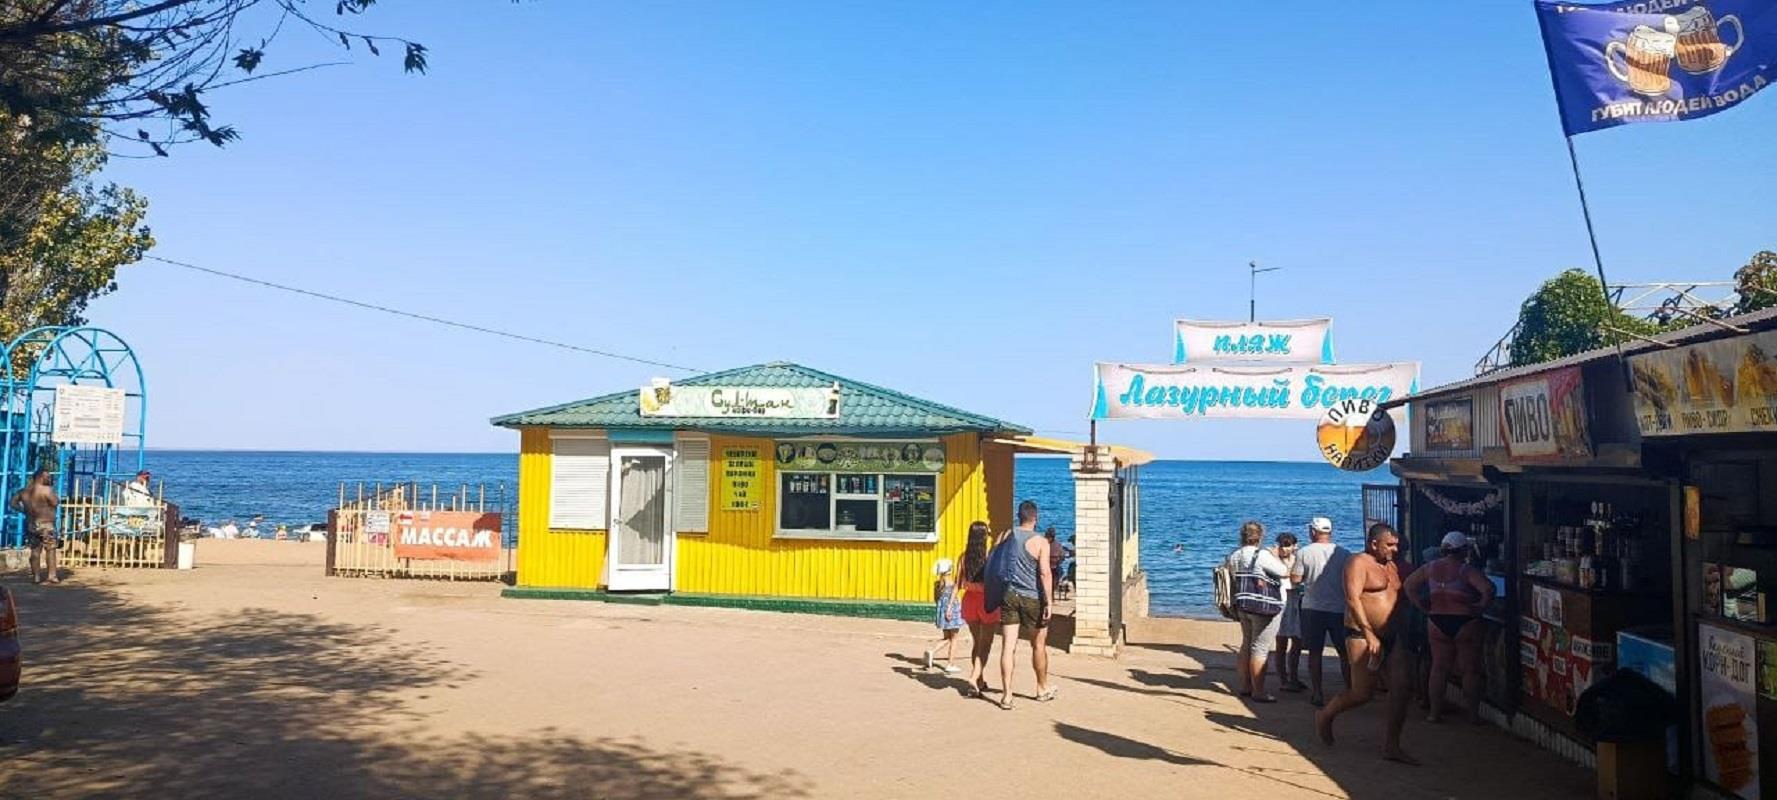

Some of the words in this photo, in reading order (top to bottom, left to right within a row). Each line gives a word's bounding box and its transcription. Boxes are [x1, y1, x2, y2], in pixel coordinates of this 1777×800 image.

[1591, 100, 1643, 122] ГУБИТ
[1644, 94, 1714, 116] ЛЮДЕЙ
[1714, 74, 1767, 107] ВОДА
[1119, 374, 1291, 416] Лазурный
[1328, 399, 1385, 423] ПИВО
[1505, 394, 1549, 443] ПИВО
[1324, 443, 1389, 470] НАПИТКИ
[401, 526, 493, 548] МАССАЖ
